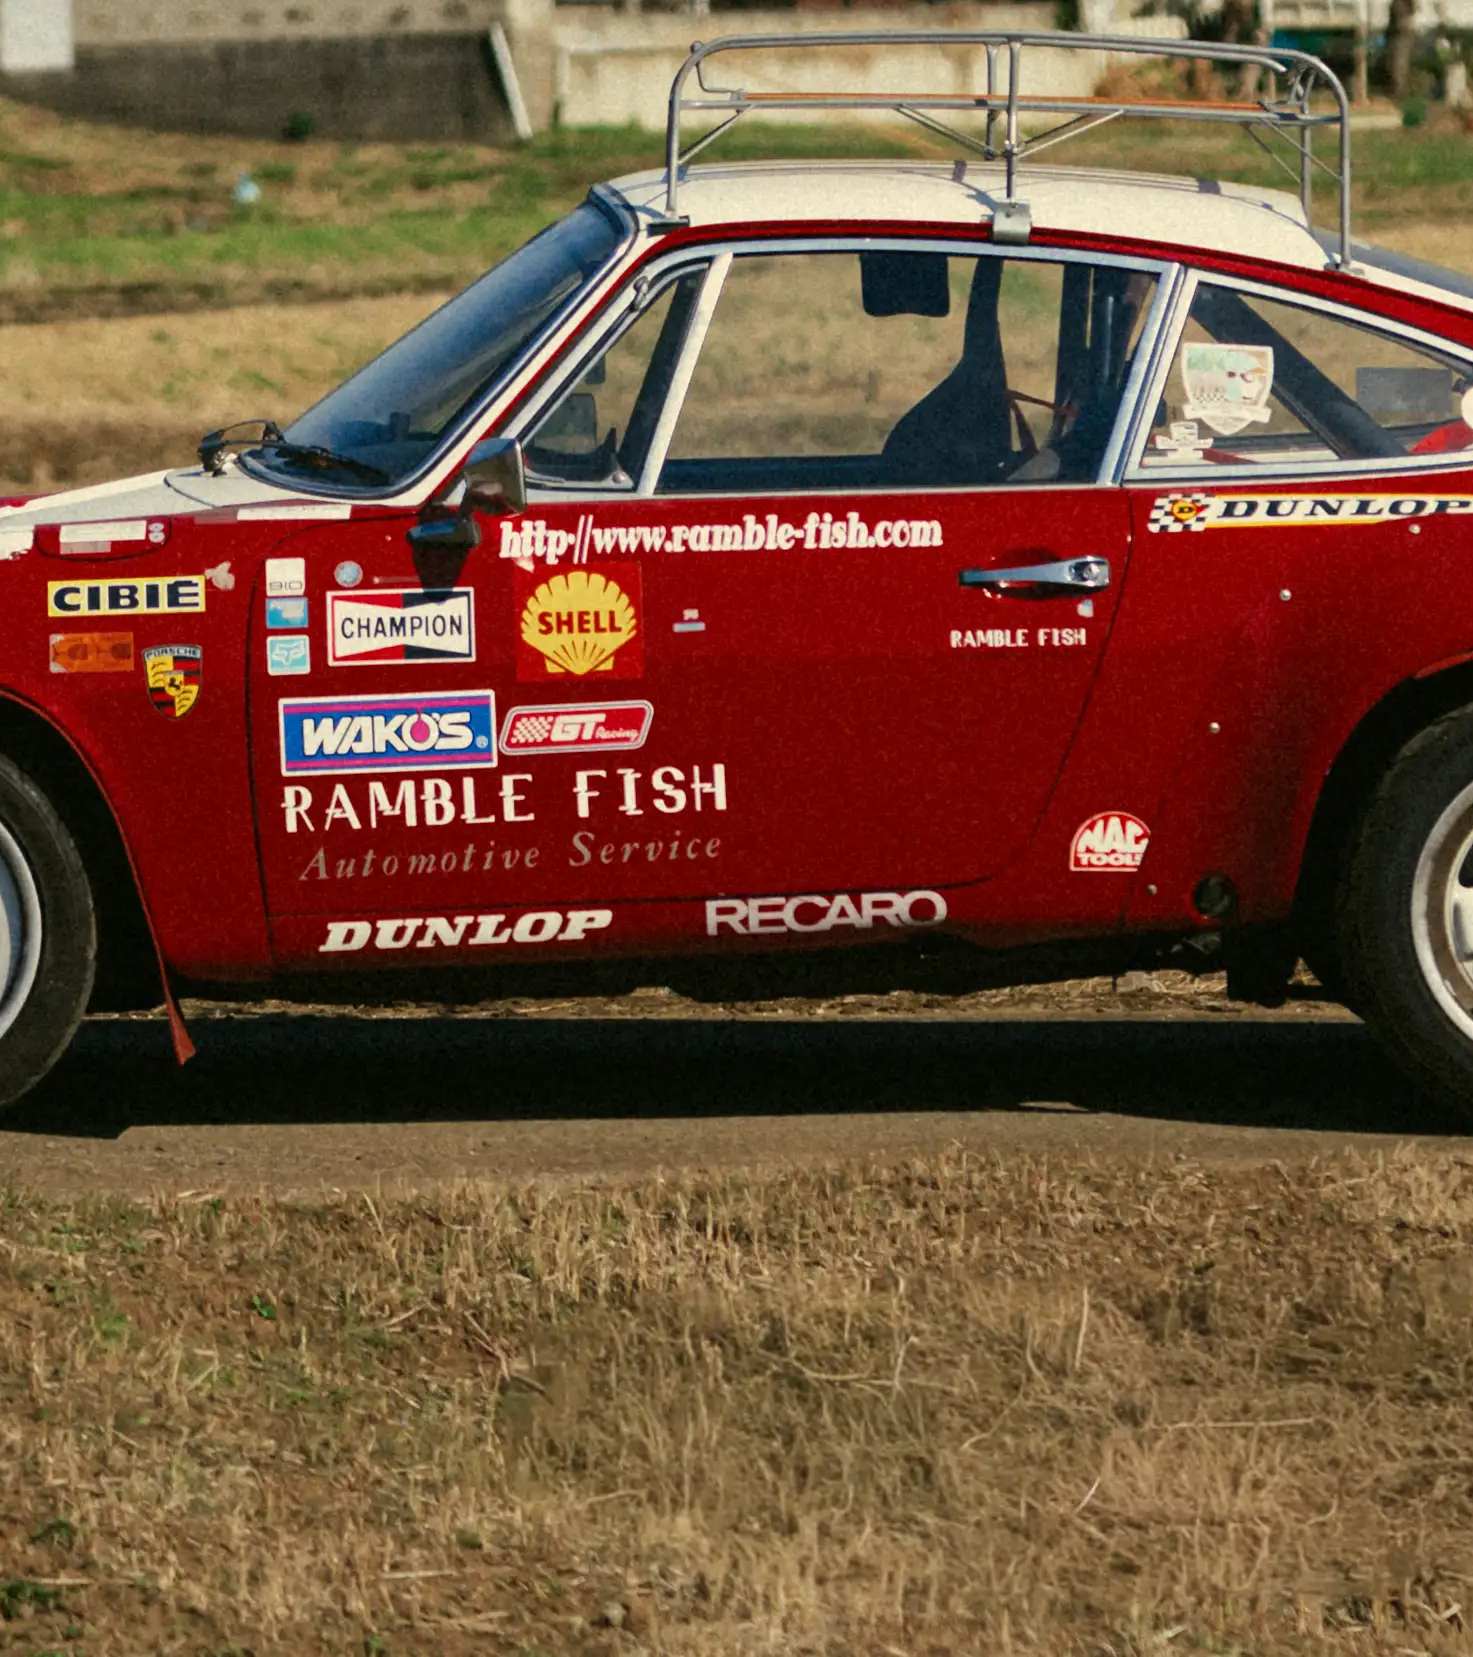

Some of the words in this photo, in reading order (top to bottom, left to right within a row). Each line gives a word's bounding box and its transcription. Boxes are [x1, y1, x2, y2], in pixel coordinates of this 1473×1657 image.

[1216, 498, 1472, 520] DUNLOP
[340, 614, 463, 639] CHAMPION
[537, 609, 623, 636] SHELL
[949, 628, 1030, 648] RAMBLE
[1037, 627, 1087, 647] FISH
[302, 711, 474, 756] WAKO'S
[549, 713, 607, 742] GT
[280, 772, 536, 833] RAMBLE
[572, 762, 727, 819] FISH
[1076, 816, 1150, 853] MAC
[299, 840, 541, 881] Automotive
[568, 829, 722, 868] Service
[318, 909, 613, 952] DUNLOP
[704, 889, 948, 936] RECARO
